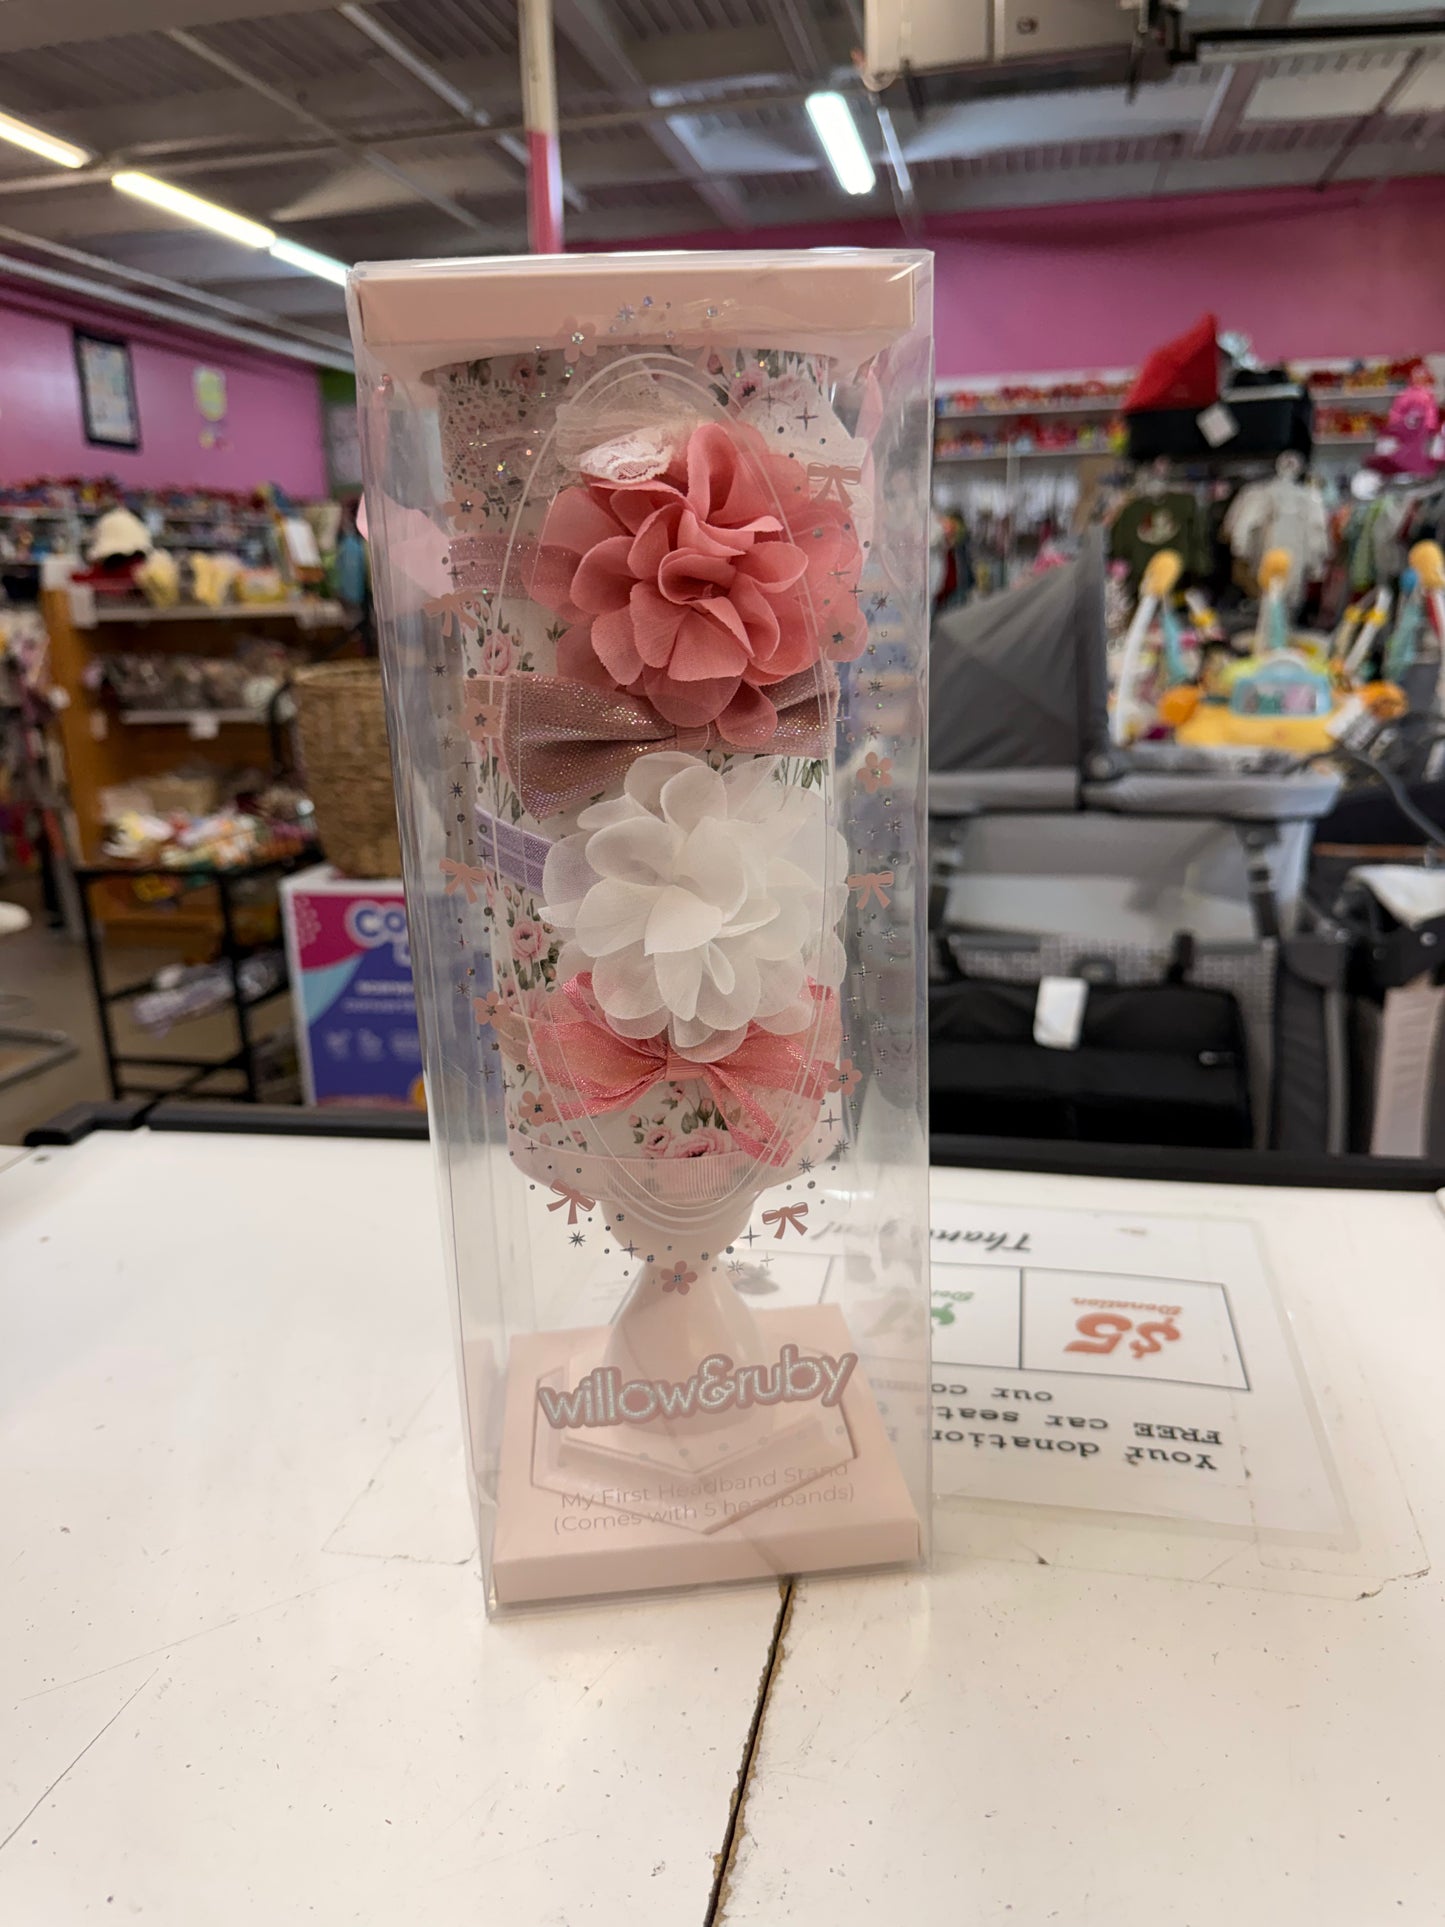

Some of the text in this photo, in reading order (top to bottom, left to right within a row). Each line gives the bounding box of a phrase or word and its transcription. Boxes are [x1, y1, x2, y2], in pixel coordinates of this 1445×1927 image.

[928, 1229, 1031, 1252] Than
[1071, 1297, 1183, 1316] Donation
[1063, 1313, 1182, 1360] $5
[538, 1344, 858, 1429] willow&ruby
[991, 1386, 1053, 1401] our
[926, 1406, 1223, 1446] FREE car seat
[1126, 1446, 1217, 1471] Your
[561, 1461, 848, 1511] My First Headband Stand
[554, 1482, 854, 1535] (Comes with 5 hebands)
